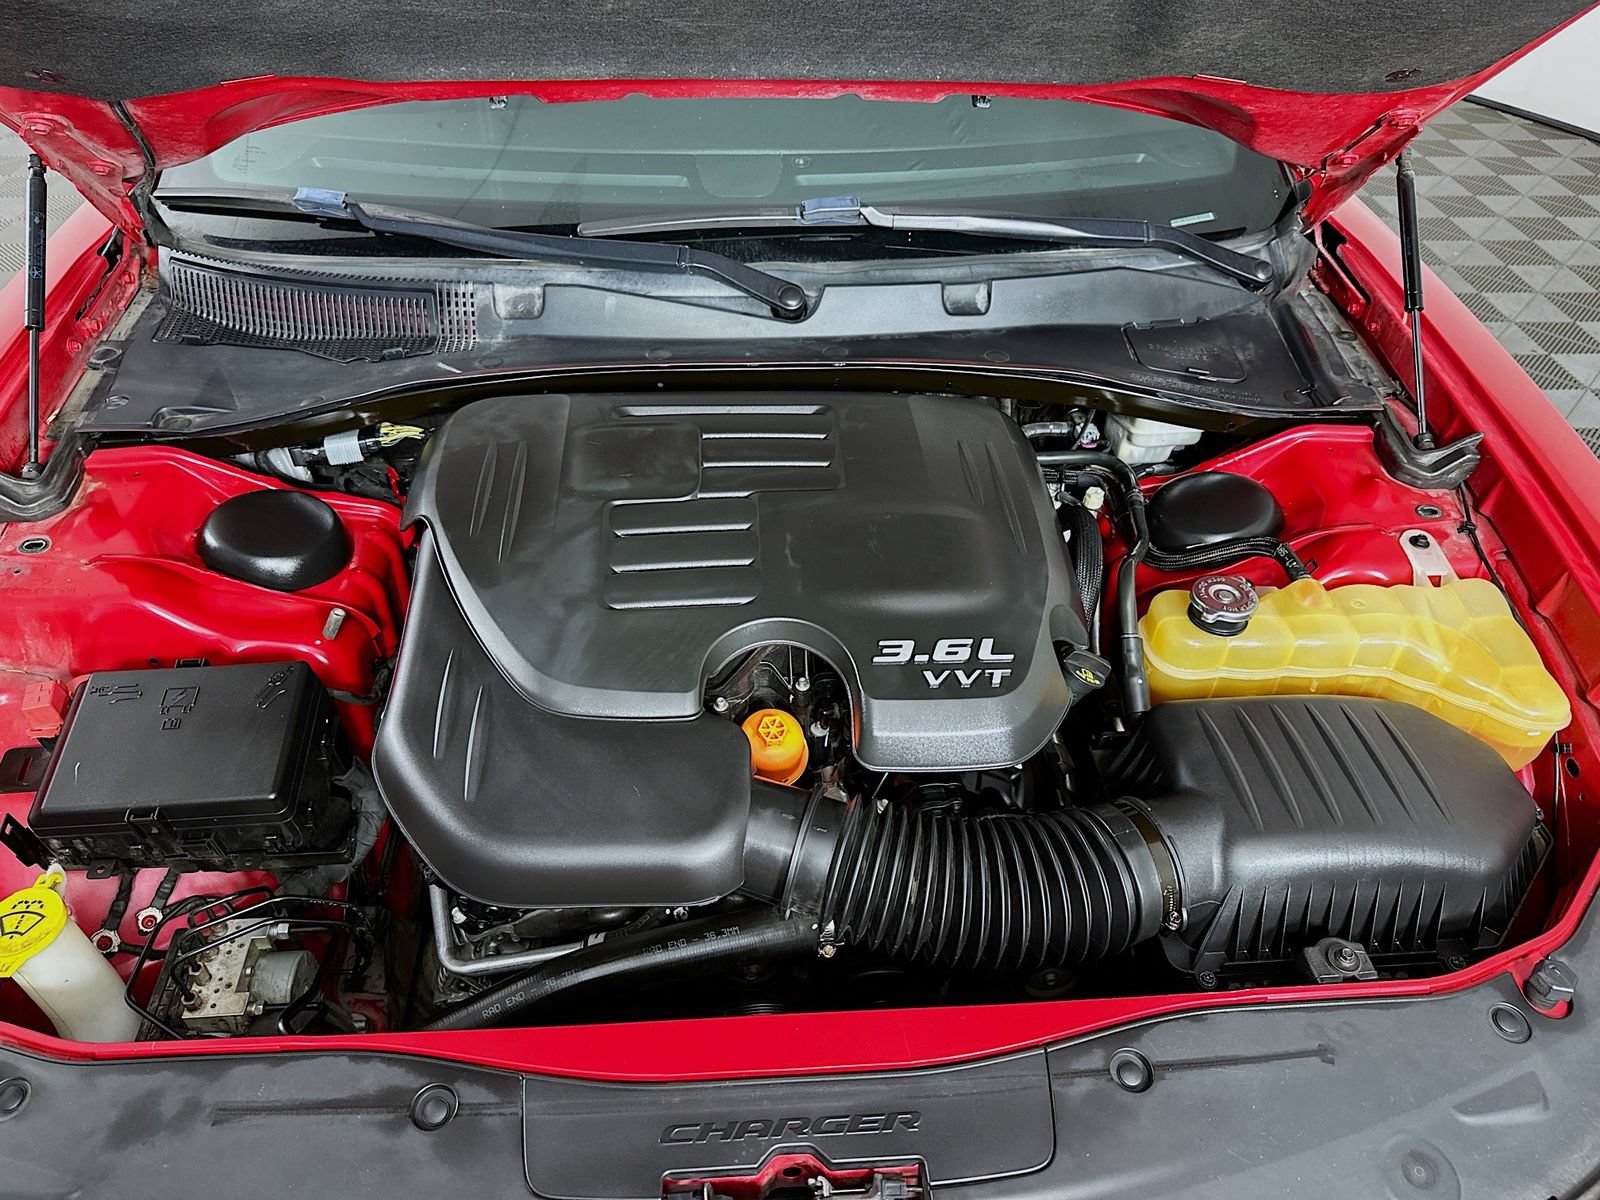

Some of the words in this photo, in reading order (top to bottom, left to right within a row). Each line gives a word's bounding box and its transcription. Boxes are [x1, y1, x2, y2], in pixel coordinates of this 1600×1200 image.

[872, 638, 1015, 665] 3.6L
[922, 669, 1012, 688] VVT
[667, 938, 687, 950] END
[703, 926, 740, 942] 36.3MM
[481, 1003, 502, 1019] RAD
[505, 991, 526, 1007] END
[658, 1110, 921, 1144] CHARGER
